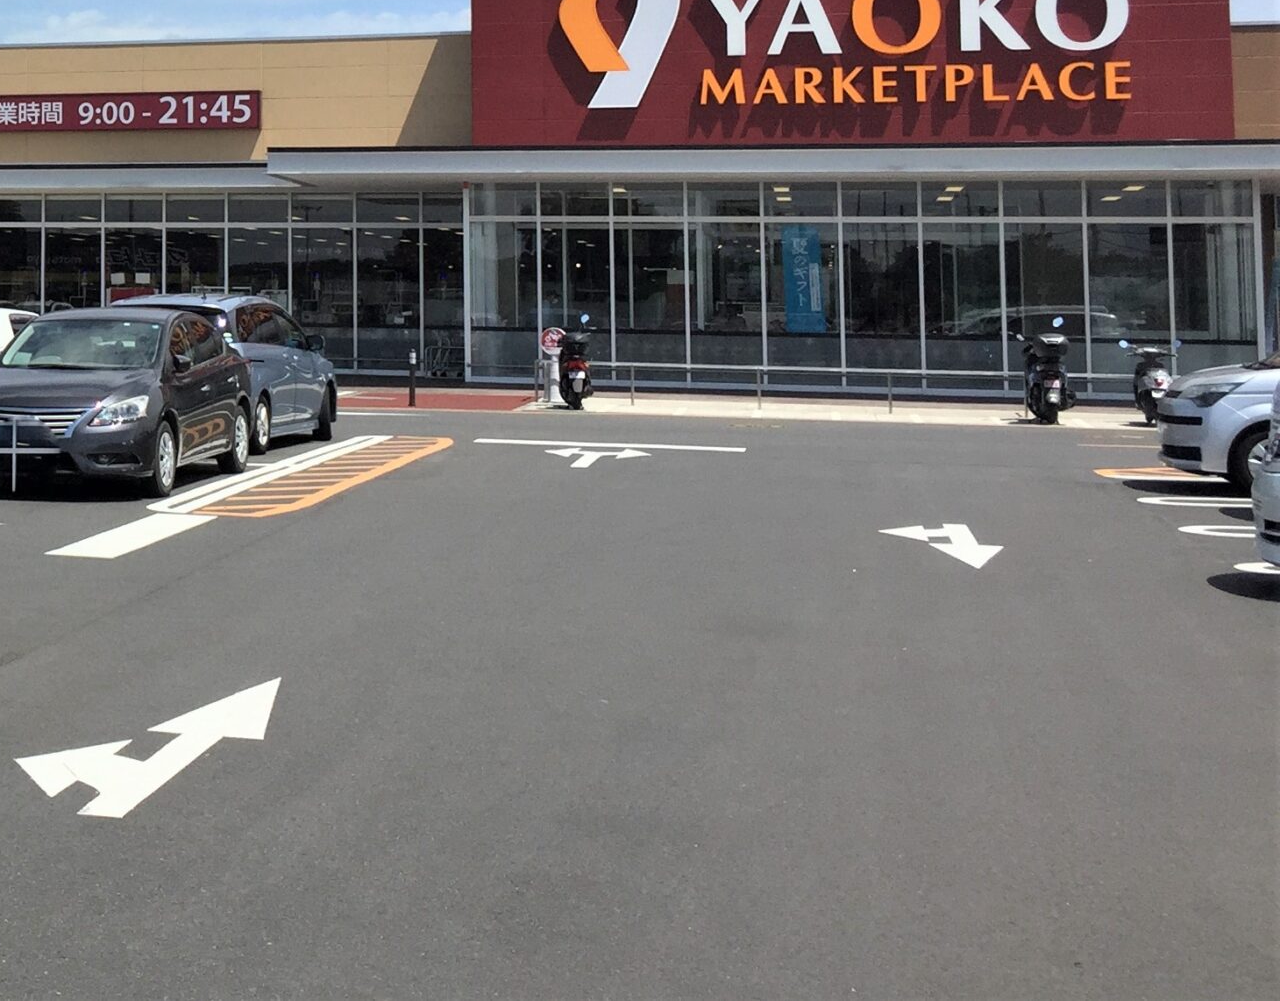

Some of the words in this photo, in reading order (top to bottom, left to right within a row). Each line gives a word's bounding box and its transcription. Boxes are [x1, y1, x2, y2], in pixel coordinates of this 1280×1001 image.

[701, 62, 1131, 104] MARKETPLACE
[78, 102, 134, 125] 9:00
[158, 95, 251, 124] 21:45
[791, 237, 809, 307] 夏のギフト
